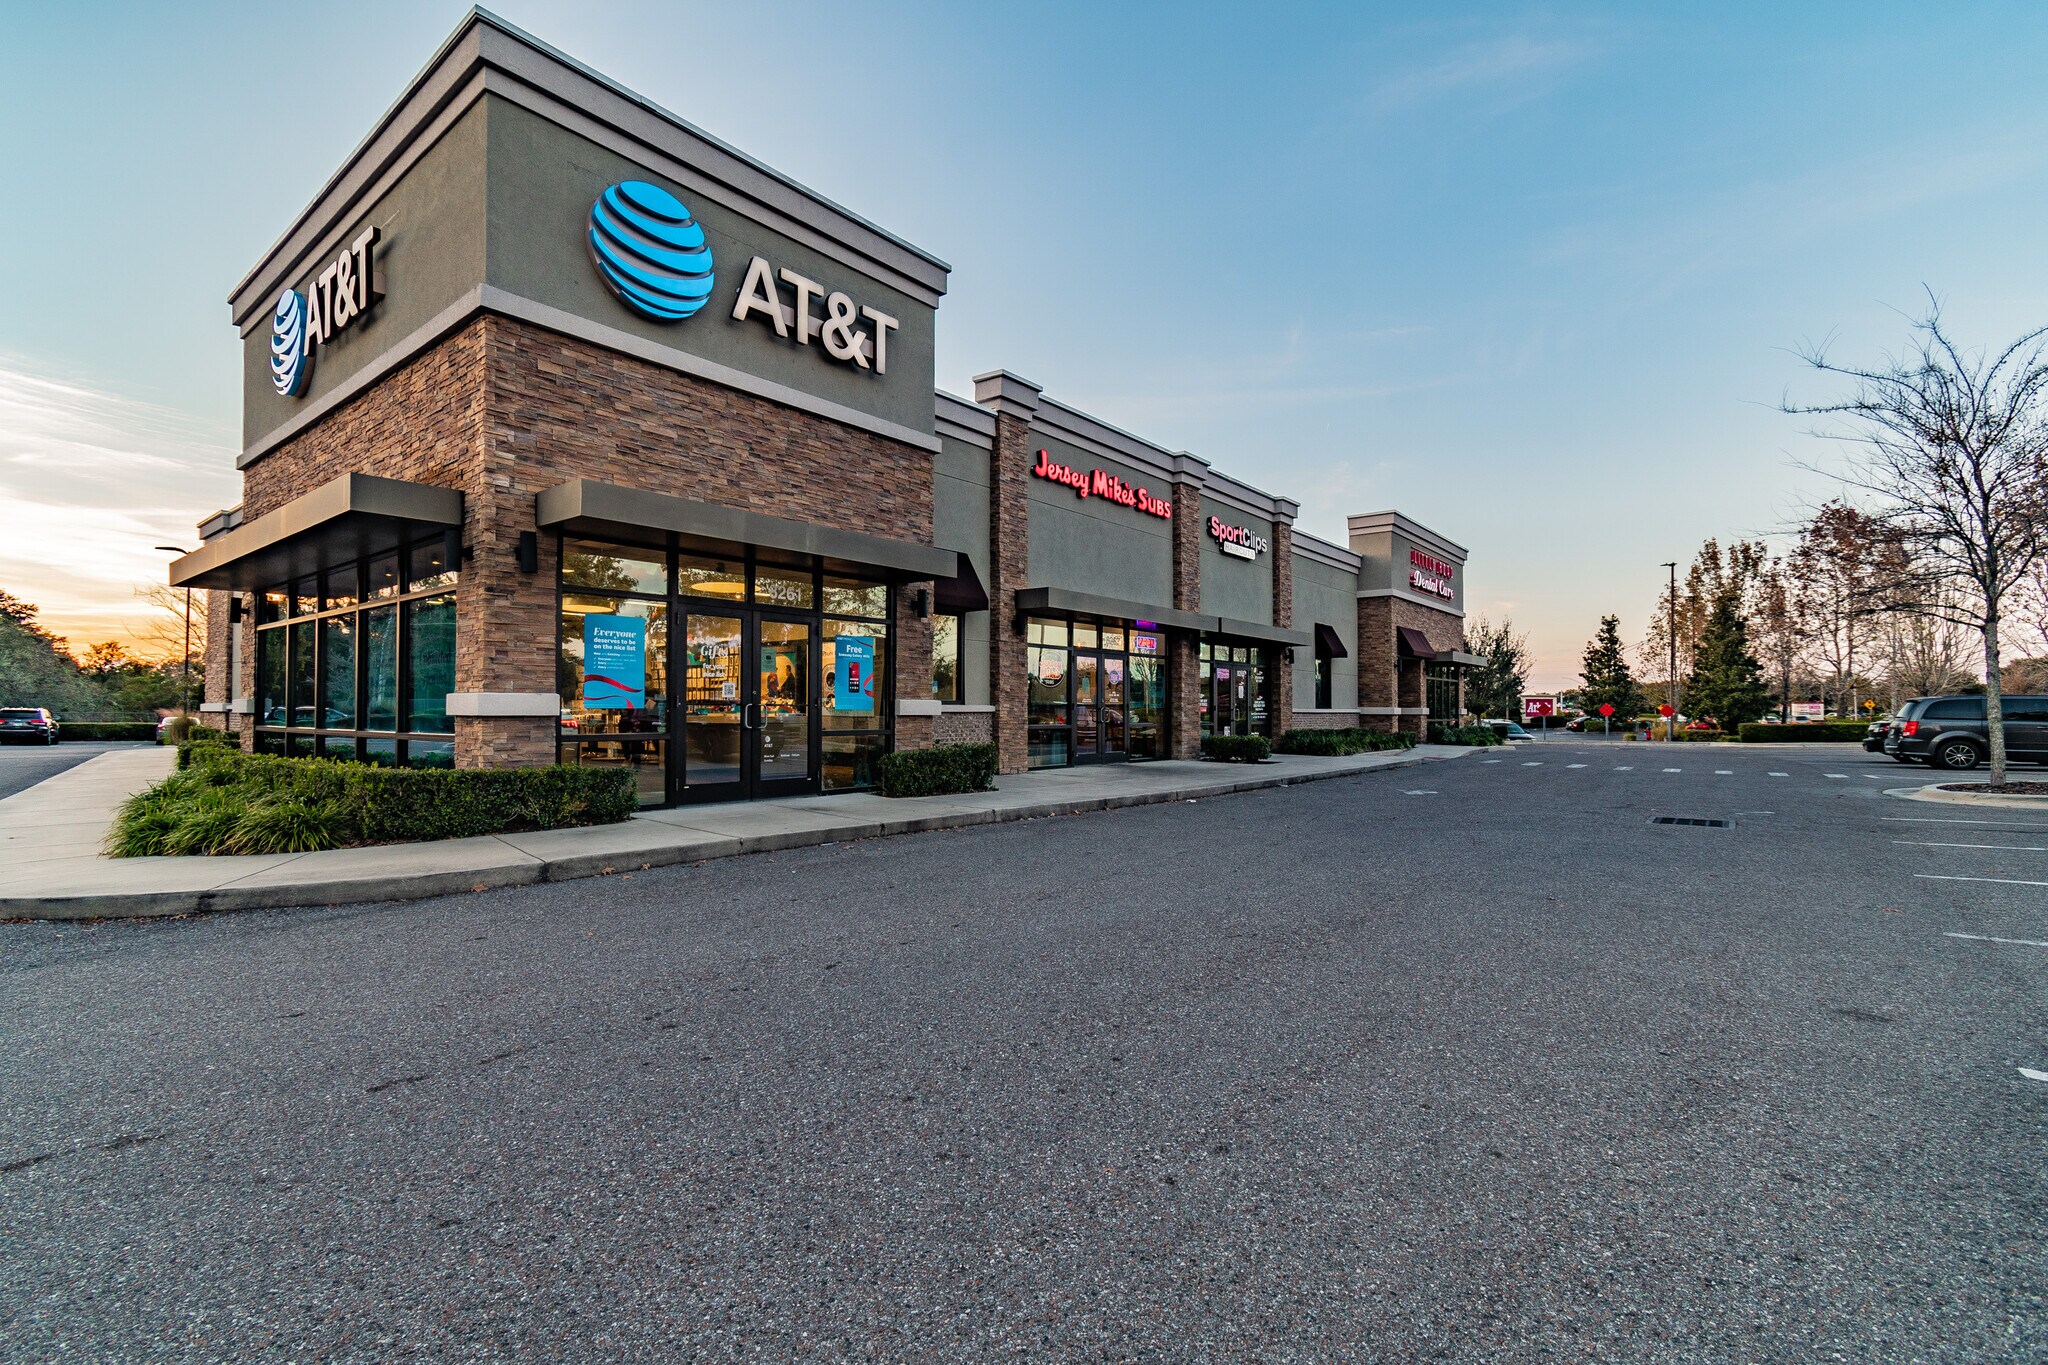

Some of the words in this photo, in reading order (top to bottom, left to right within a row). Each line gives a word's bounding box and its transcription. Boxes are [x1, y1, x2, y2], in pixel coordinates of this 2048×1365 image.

[303, 225, 375, 357] AT&T
[731, 255, 900, 375] AT&T
[1034, 449, 1090, 499] Jersey
[1092, 468, 1137, 507] Mike's
[770, 584, 802, 602] 8261
[1413, 570, 1439, 593] Dental
[1439, 580, 1455, 599] Care
[593, 627, 637, 639] Everyone
[593, 637, 620, 645] deserves
[846, 645, 863, 654] Free
